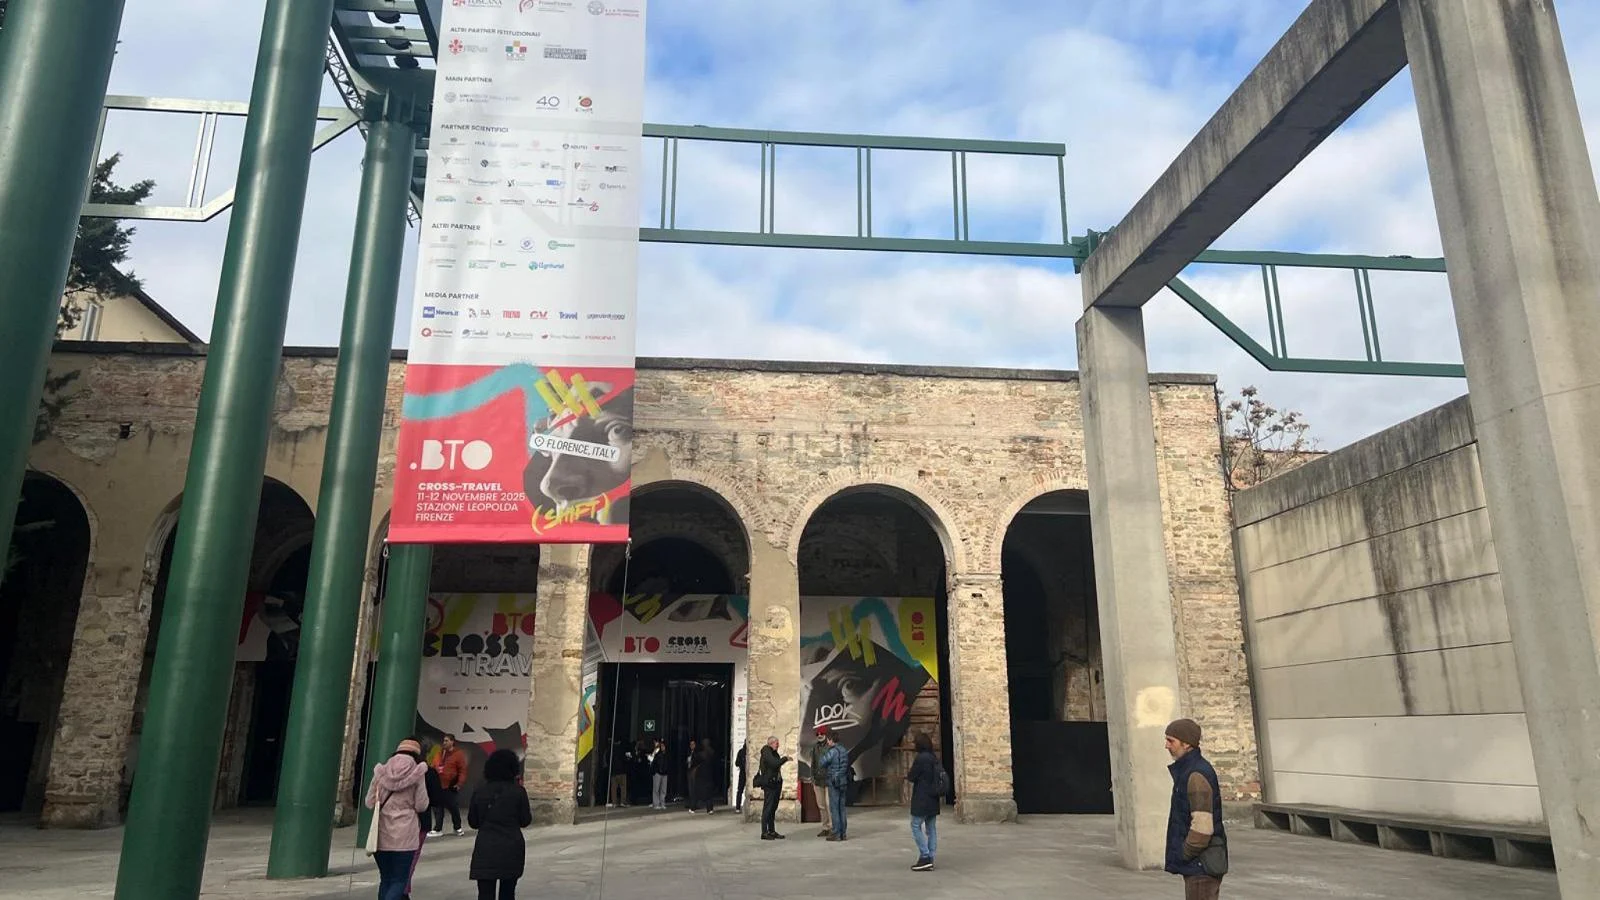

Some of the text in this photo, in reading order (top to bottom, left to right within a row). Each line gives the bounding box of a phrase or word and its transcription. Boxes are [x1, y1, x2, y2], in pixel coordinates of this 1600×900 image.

[472, 124, 509, 133] SCIENTIFICI
[450, 223, 481, 231] PARTNER
[416, 492, 440, 501] 11-12
[442, 492, 498, 502] NOVEMBRE
[416, 502, 519, 512] STAZIONE LEOPOLDA
[415, 512, 455, 522] FIRENZE
[813, 702, 862, 726] LOOK
